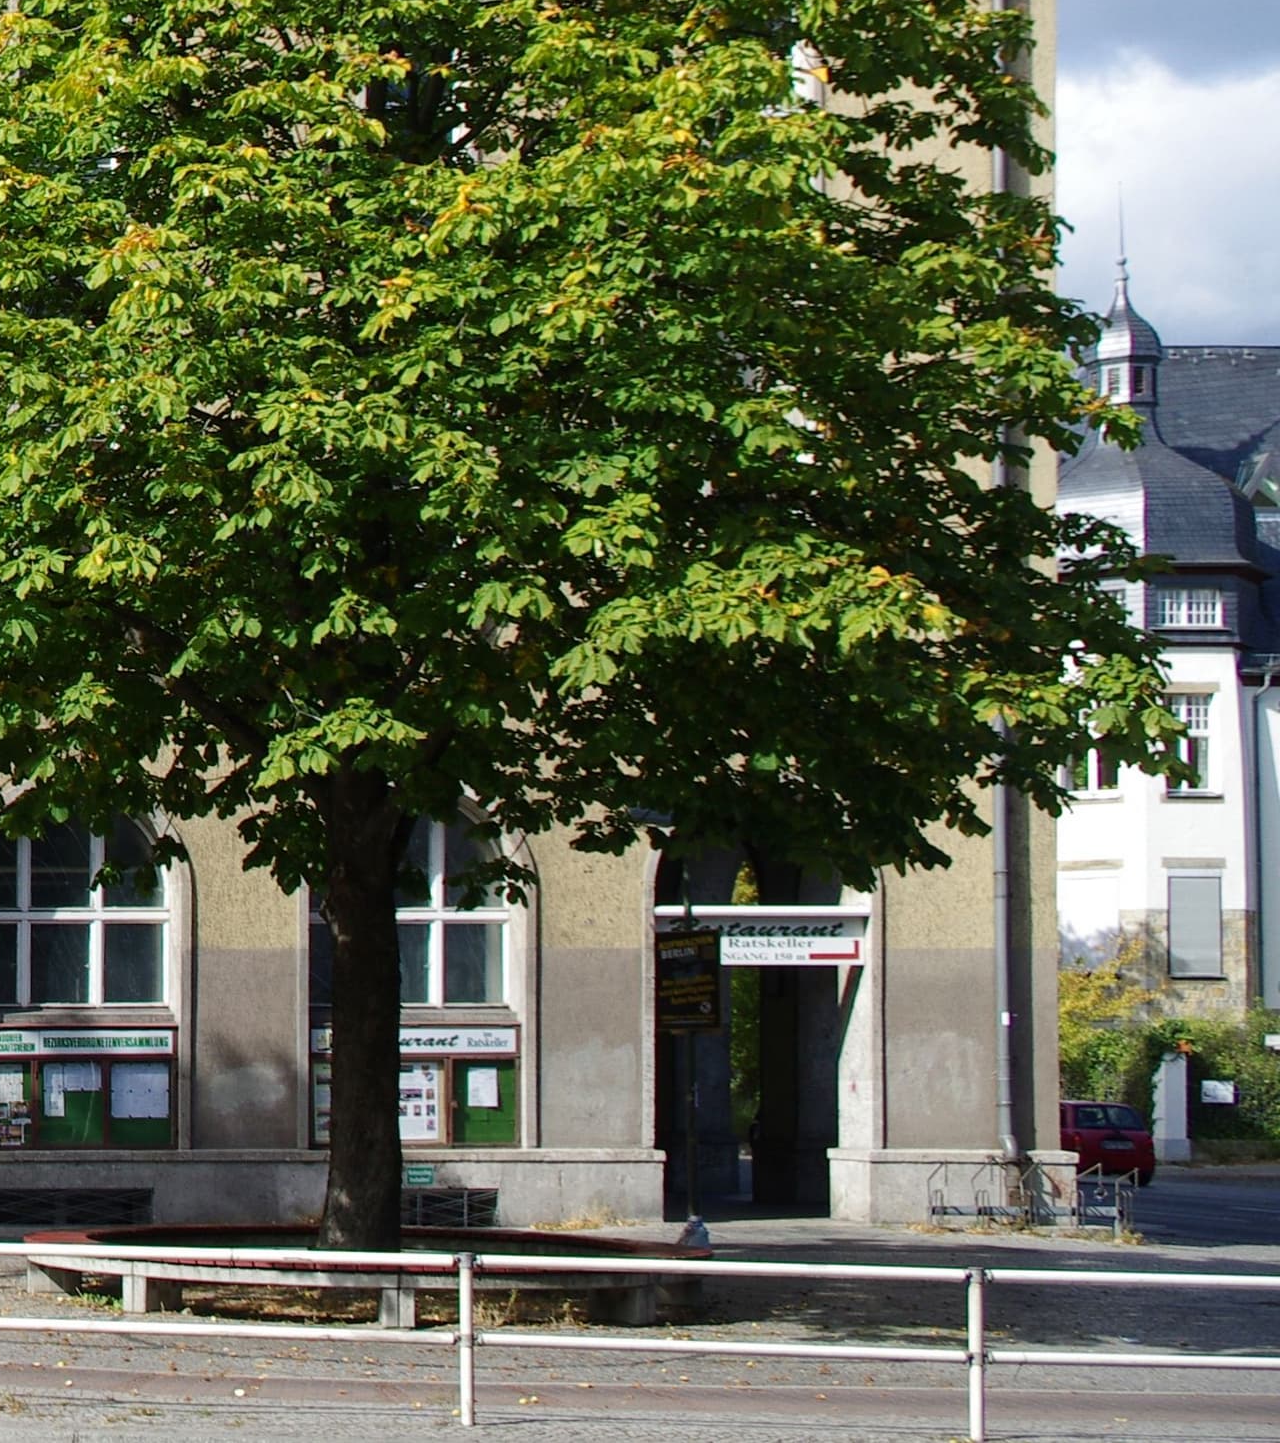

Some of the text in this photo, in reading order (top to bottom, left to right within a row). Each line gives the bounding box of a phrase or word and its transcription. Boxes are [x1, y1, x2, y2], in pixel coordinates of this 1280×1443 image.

[727, 938, 815, 949] Ratskeller
[722, 952, 769, 961] NGANG
[400, 1034, 459, 1048] urant
[466, 1037, 509, 1048] Ratskeller
